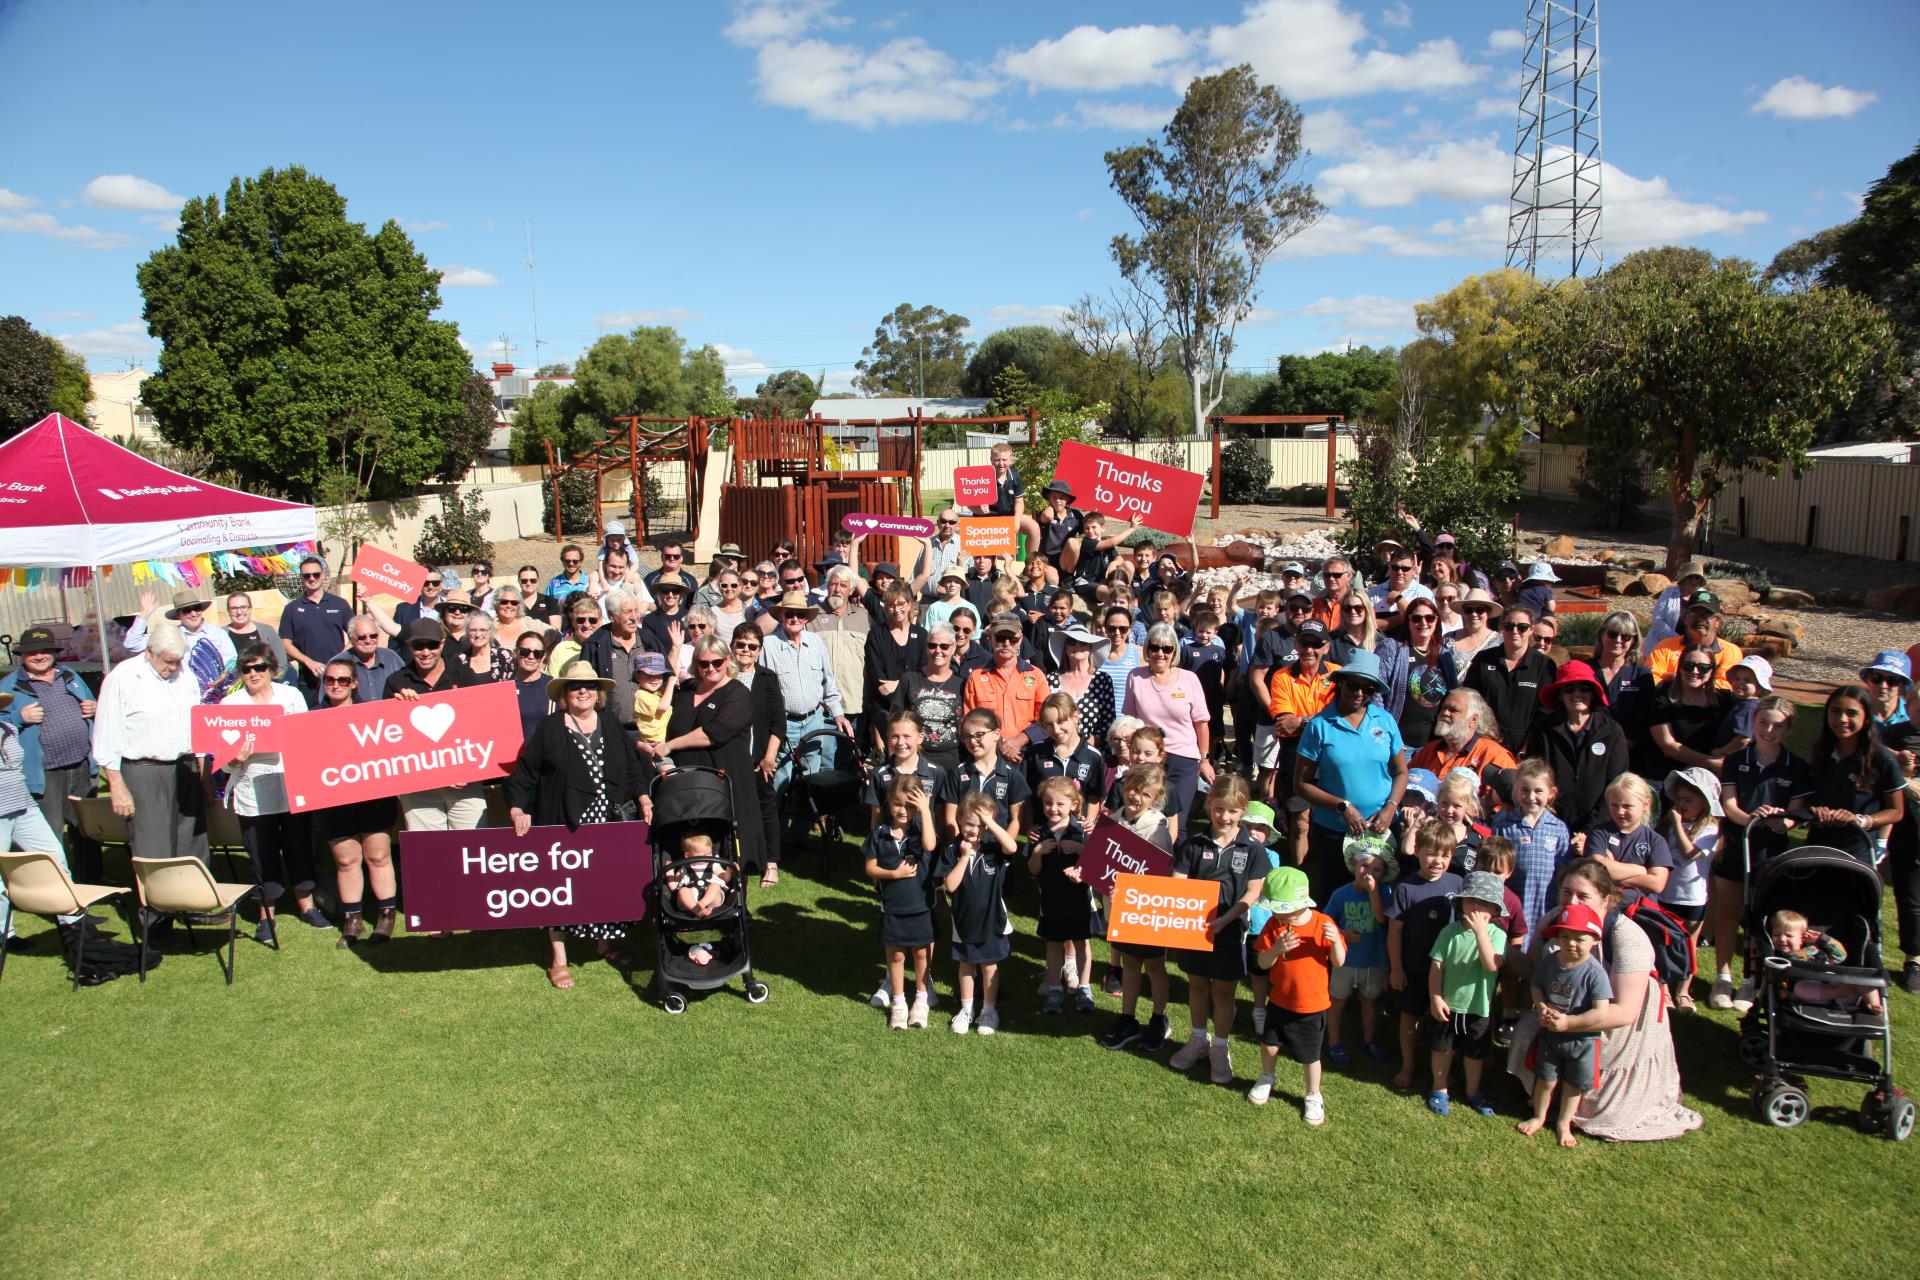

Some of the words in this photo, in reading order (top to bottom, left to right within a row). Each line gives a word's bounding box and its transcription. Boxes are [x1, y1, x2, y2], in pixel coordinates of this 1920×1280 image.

[960, 477, 990, 485] Thanks
[1096, 459, 1162, 492] Thanks
[7, 482, 47, 492] Bank
[118, 486, 171, 496] Bendigo
[973, 488, 989, 496] you
[1095, 485, 1113, 503] to
[1116, 494, 1152, 514] you
[177, 518, 228, 532] Community
[230, 517, 251, 526] Bank
[880, 522, 928, 533] community
[966, 526, 1009, 536] Sponsor
[223, 534, 228, 542] &
[229, 533, 257, 541] Districts
[966, 537, 1010, 548] recipient
[383, 563, 400, 576] Our
[361, 568, 413, 594] community
[204, 716, 246, 727] Where
[250, 716, 271, 726] the
[246, 731, 256, 742] is
[348, 719, 403, 747] We
[321, 738, 493, 787] community
[462, 847, 539, 874] Here
[548, 842, 593, 870] for
[1105, 838, 1149, 875] Thank
[487, 877, 572, 918] good
[1125, 889, 1207, 911] Sponsor
[1120, 910, 1206, 931] recipient
